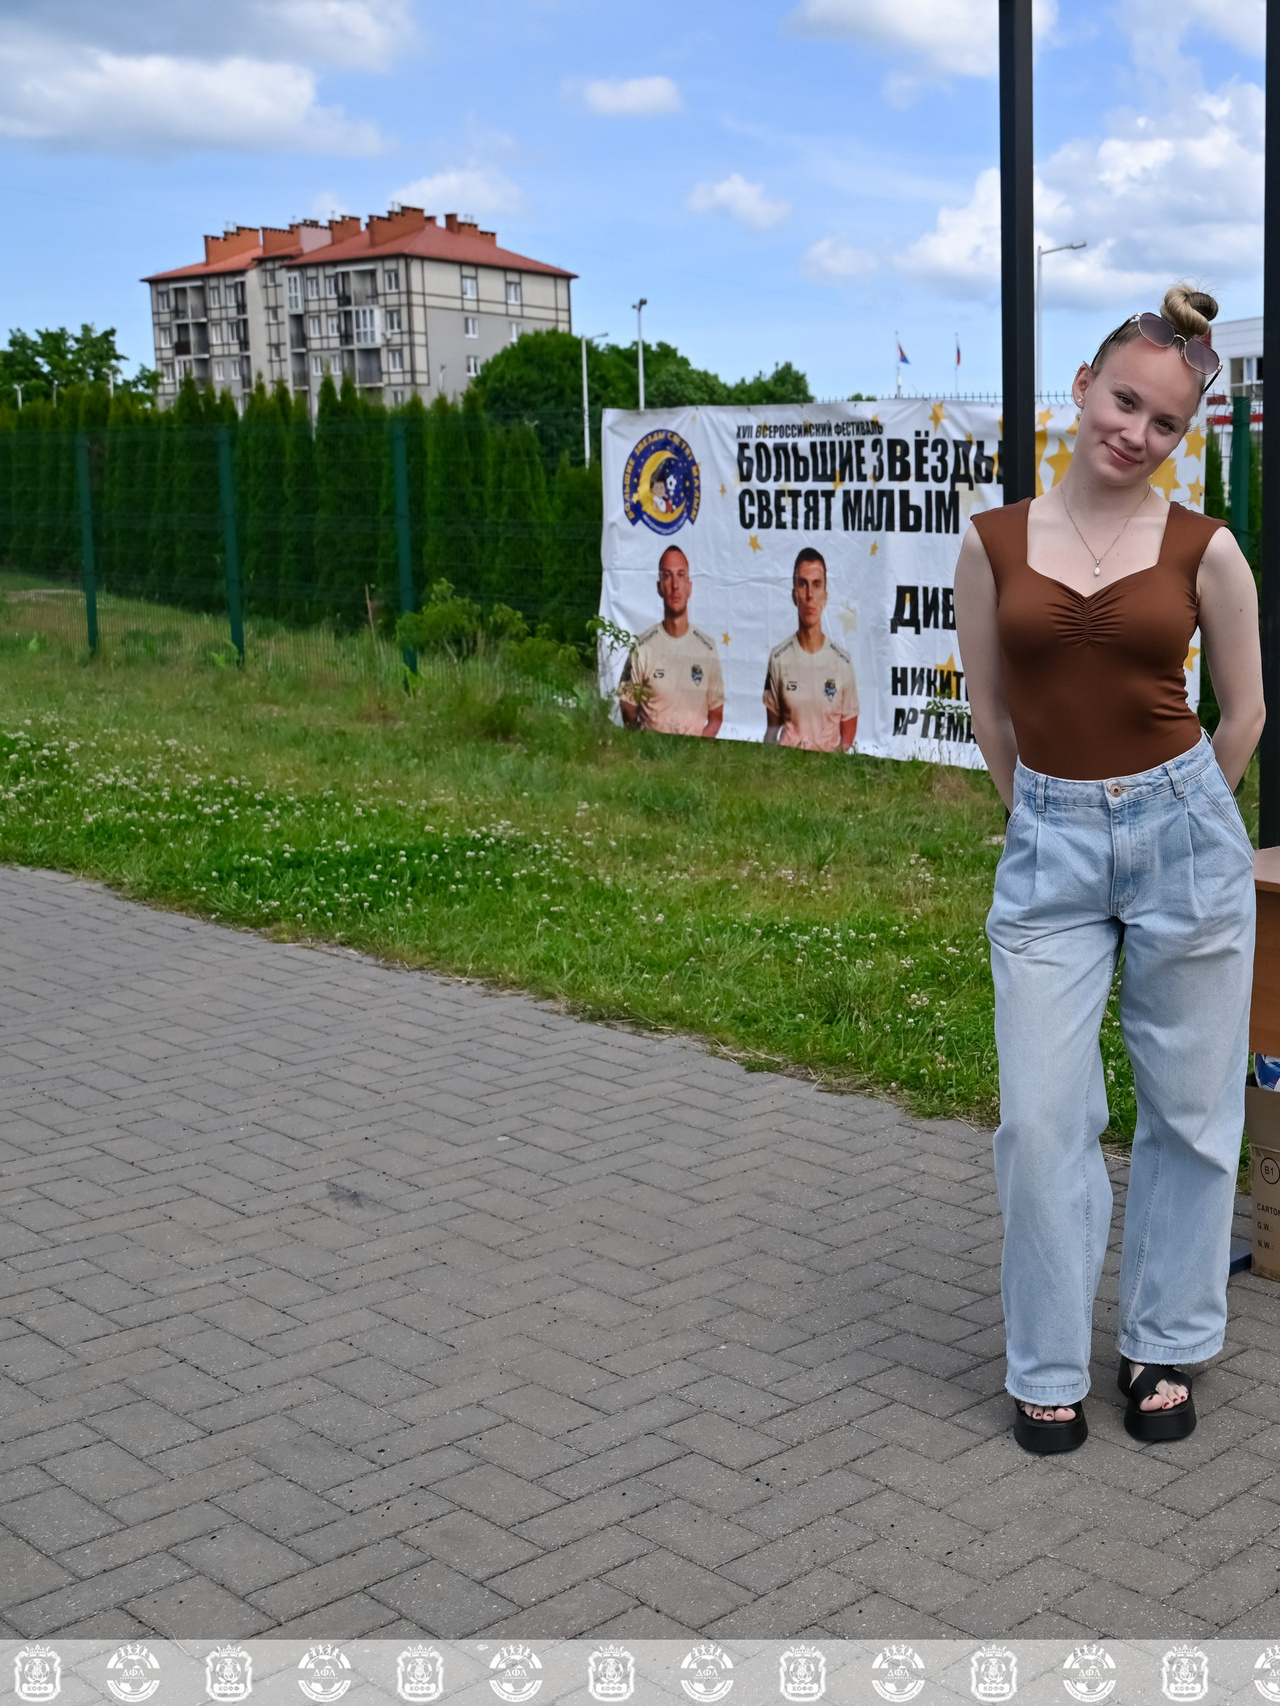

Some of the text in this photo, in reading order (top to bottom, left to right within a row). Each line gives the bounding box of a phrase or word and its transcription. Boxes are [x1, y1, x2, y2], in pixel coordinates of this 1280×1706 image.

[755, 421, 833, 439] ВСЕРОССИЙСКИЙ
[834, 420, 884, 436] ФЕСТИВАЛЬ
[737, 439, 867, 483] БОЛЬШИЕ
[738, 489, 836, 530] СВЕТЯТ
[842, 489, 960, 534] МАЛЫМ
[891, 666, 970, 702] НИКИТ
[1265, 1165, 1274, 1176] B1
